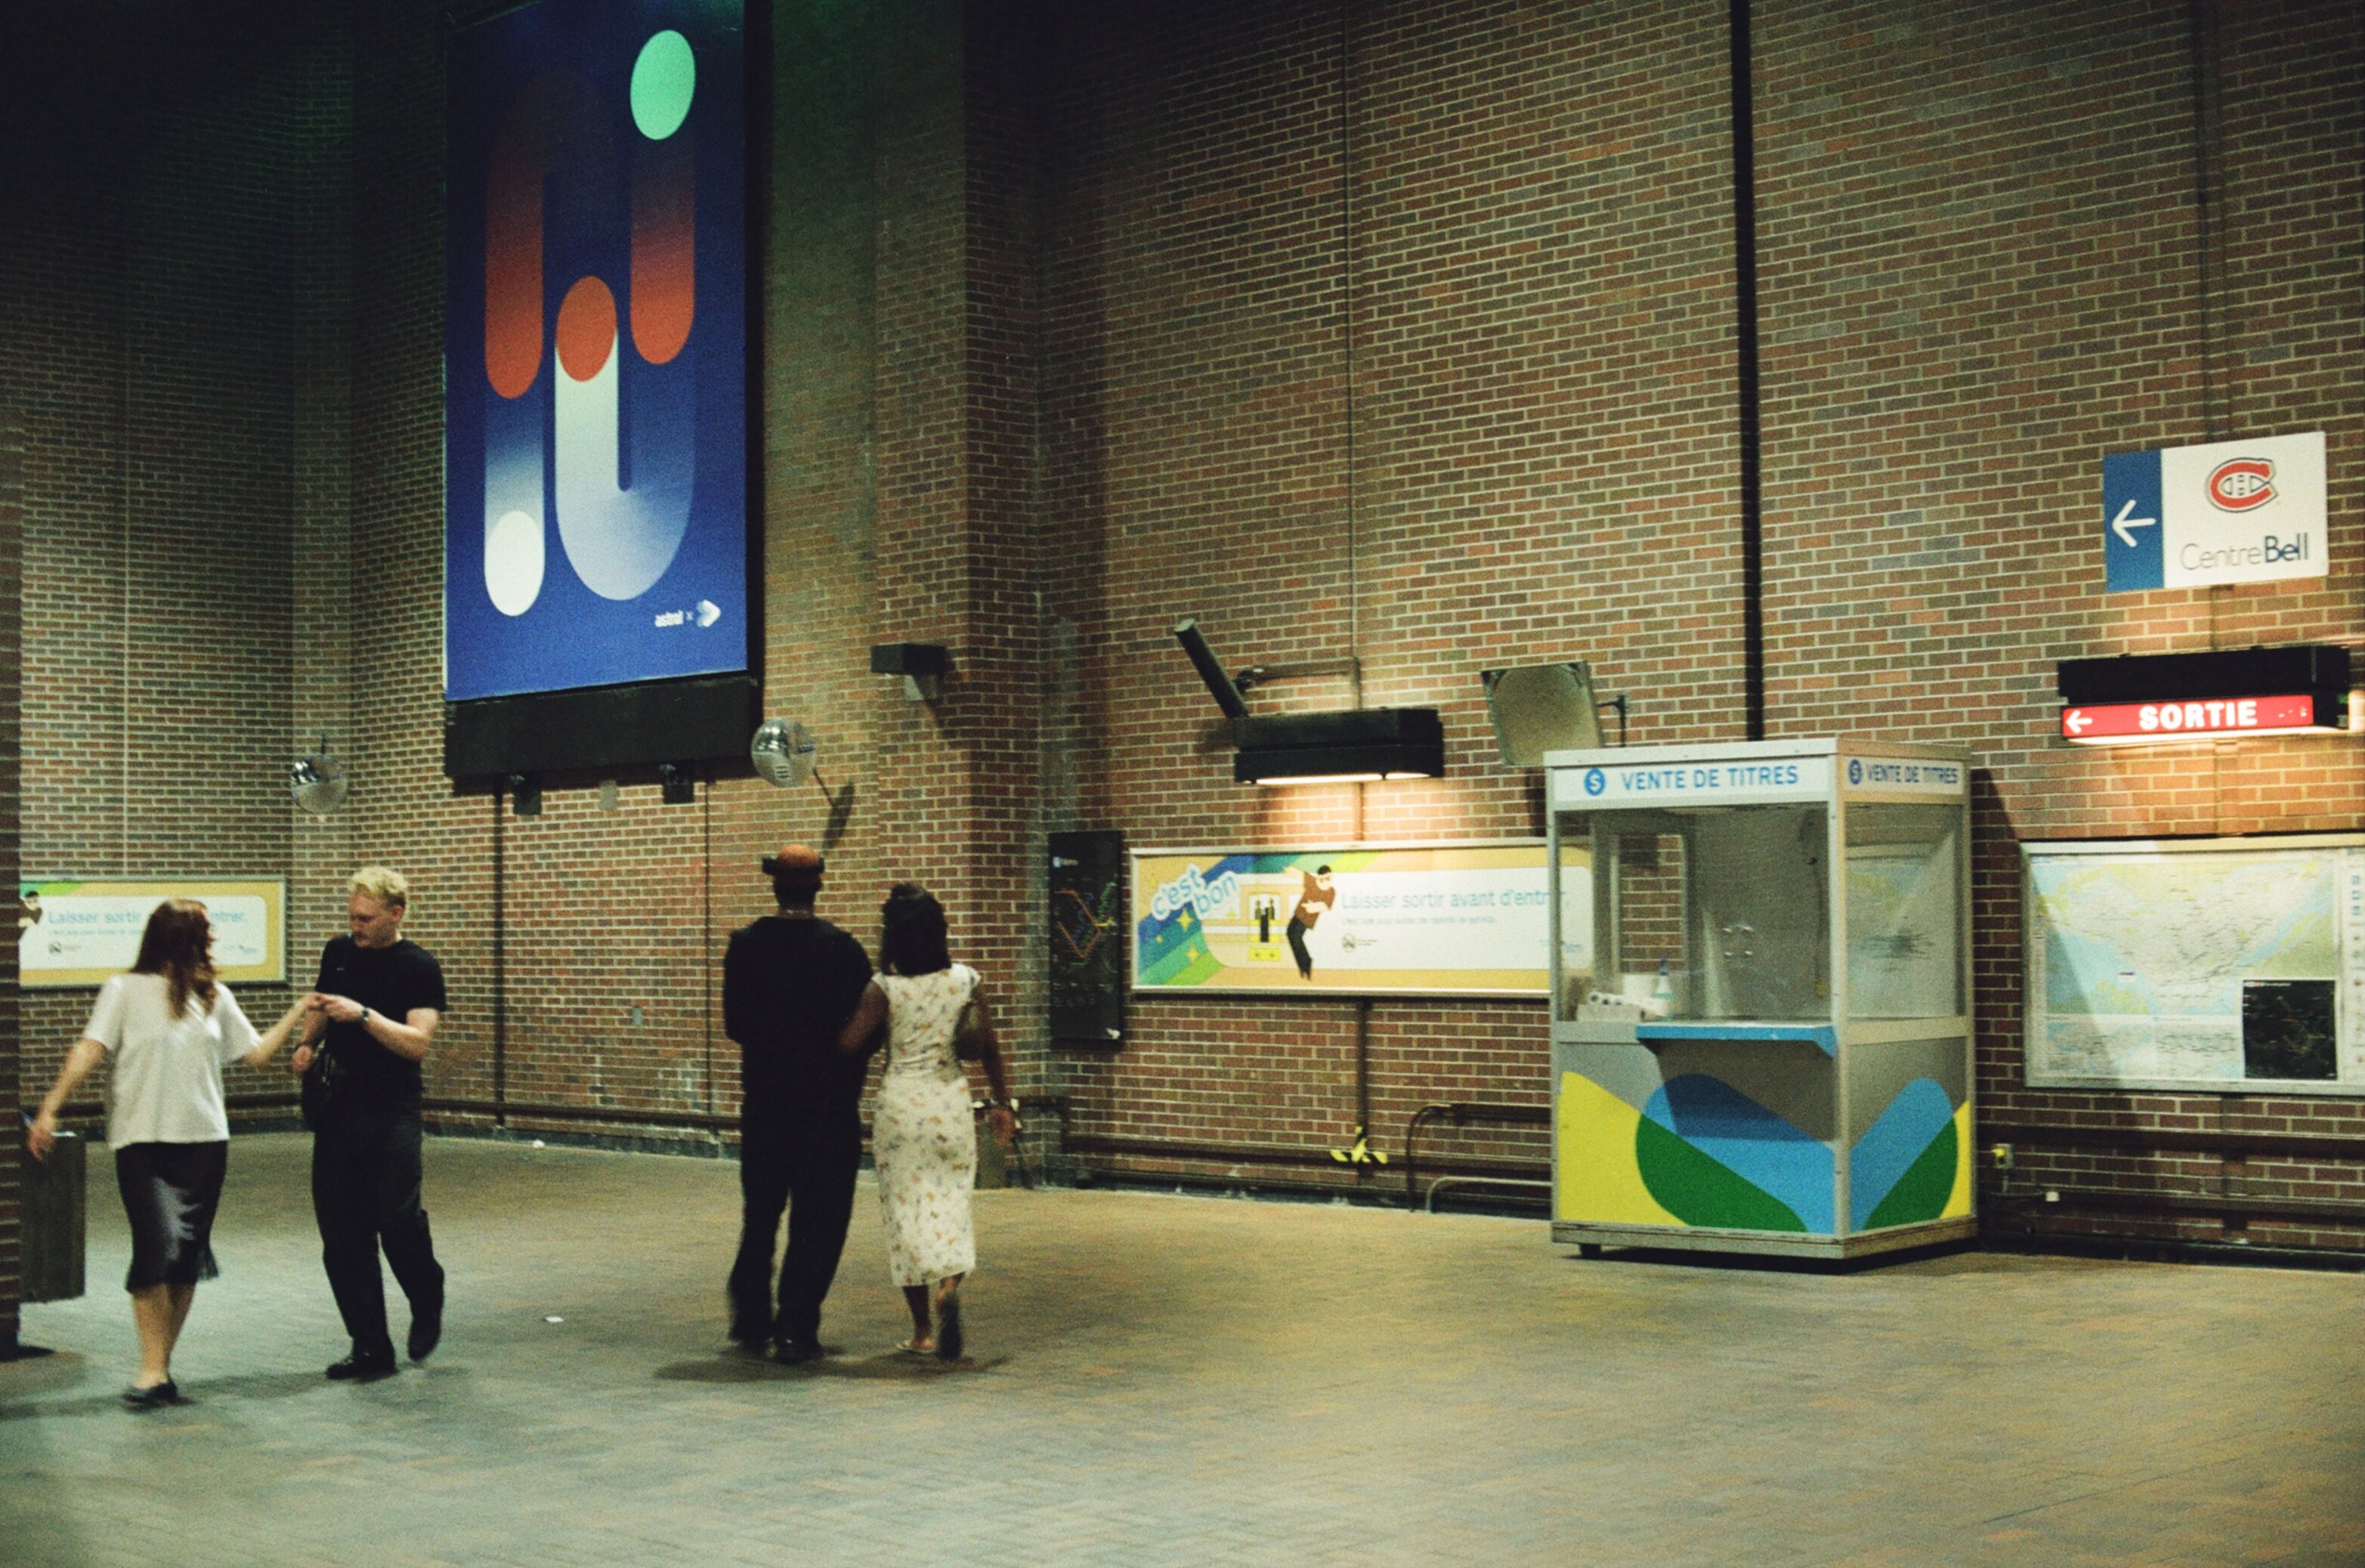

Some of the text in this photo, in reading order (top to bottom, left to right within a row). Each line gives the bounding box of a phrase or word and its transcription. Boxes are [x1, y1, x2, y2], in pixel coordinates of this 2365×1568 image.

[2138, 700, 2258, 731] SORTIE
[1621, 765, 1799, 791] VENTE DE TITRES
[1866, 764, 1958, 784] VENTE DE TITRES
[1152, 868, 1202, 916] c'est
[1194, 875, 1238, 914] bon
[1341, 892, 1395, 909] Laisser
[1402, 891, 1445, 908] sortir
[1450, 890, 1495, 908] avant
